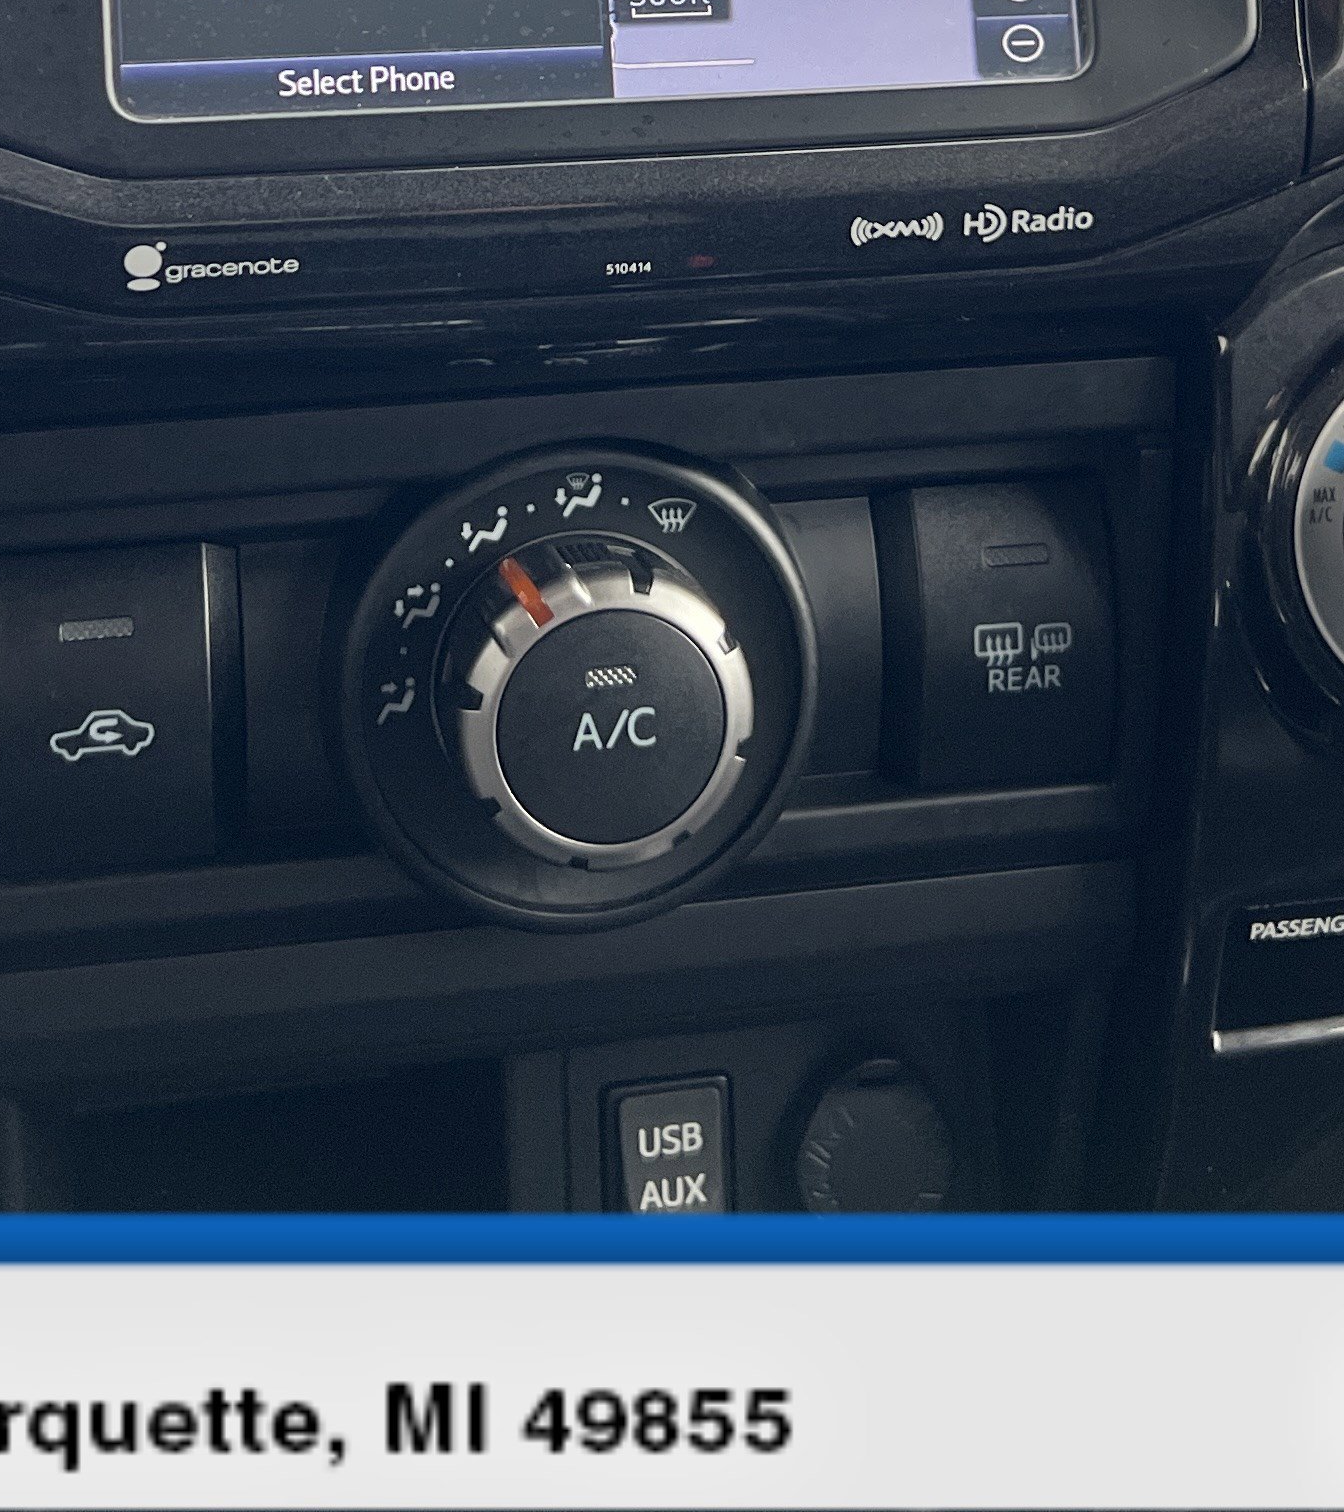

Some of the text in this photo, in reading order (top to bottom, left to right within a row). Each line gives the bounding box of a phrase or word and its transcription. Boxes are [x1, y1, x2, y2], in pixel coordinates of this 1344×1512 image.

[277, 64, 456, 97] Select Phone
[1011, 205, 1094, 234] Radio
[164, 257, 301, 285] gracenote
[605, 261, 652, 276] 510414
[986, 662, 1062, 693] REAR
[573, 705, 658, 753] A/C
[638, 1121, 704, 1158] USB
[640, 1172, 707, 1211] AUX
